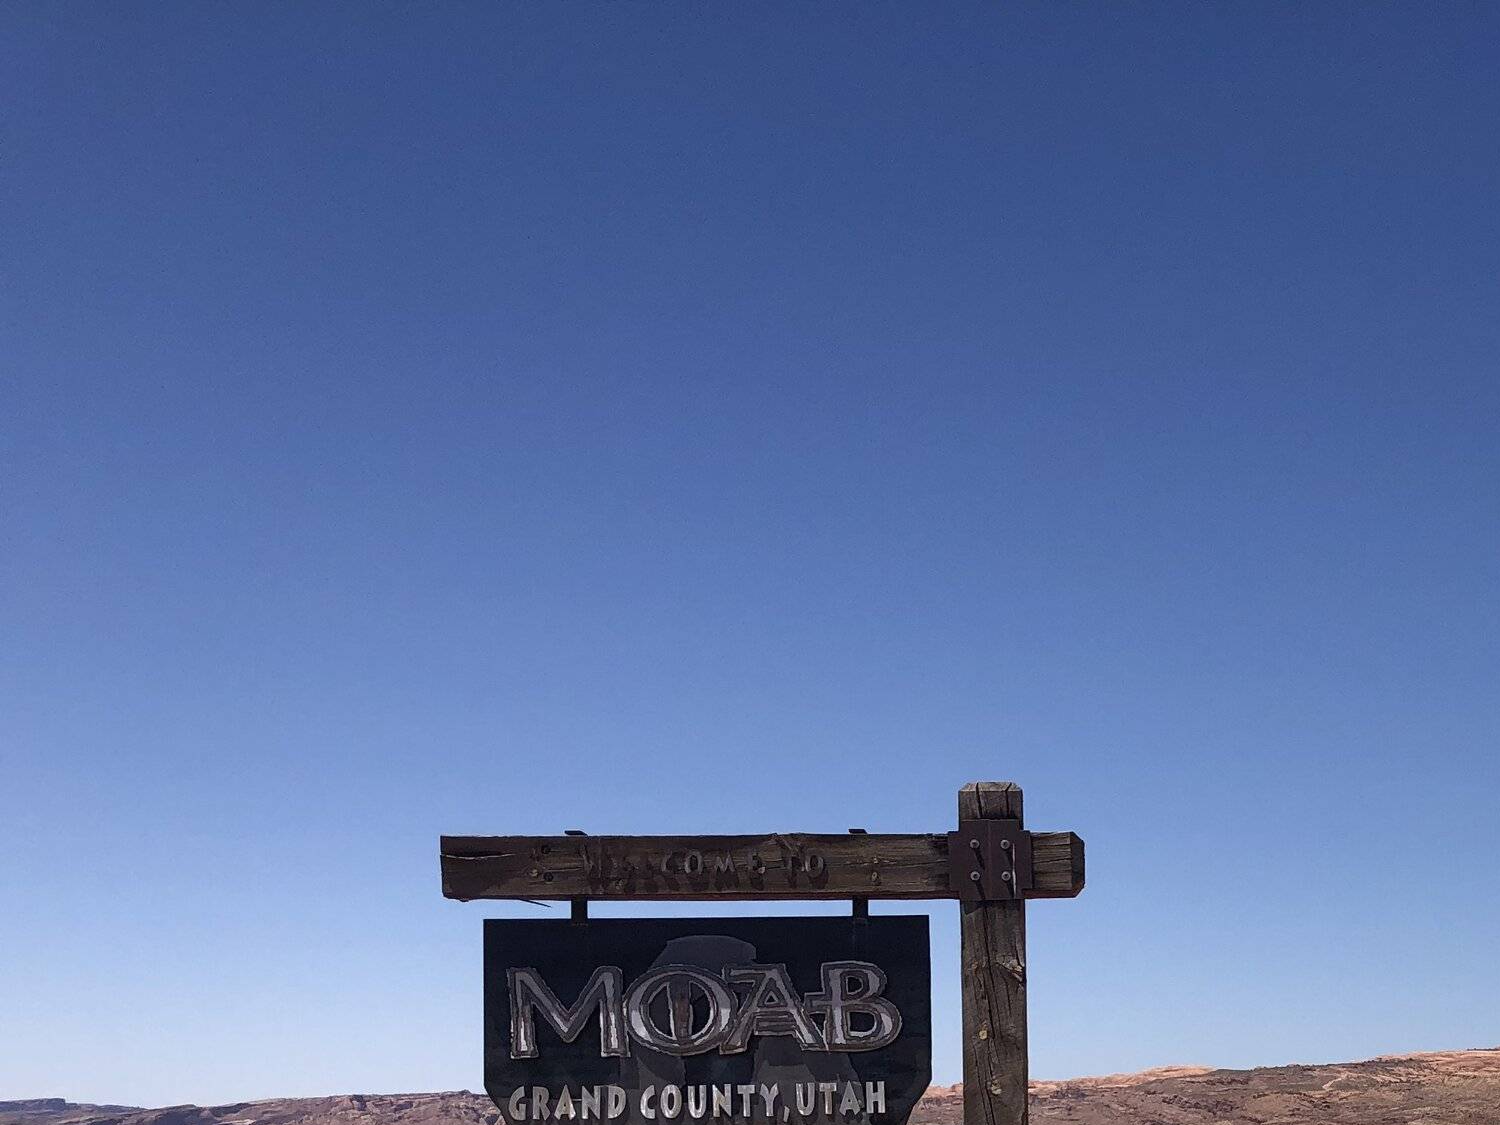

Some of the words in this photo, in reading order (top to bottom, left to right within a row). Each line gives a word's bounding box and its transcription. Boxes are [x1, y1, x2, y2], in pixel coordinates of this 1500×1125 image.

[506, 960, 902, 1059] MOAB
[508, 1084, 627, 1121] GRAND
[640, 1083, 790, 1124] COUNTY,
[796, 1081, 887, 1118] UTAH
